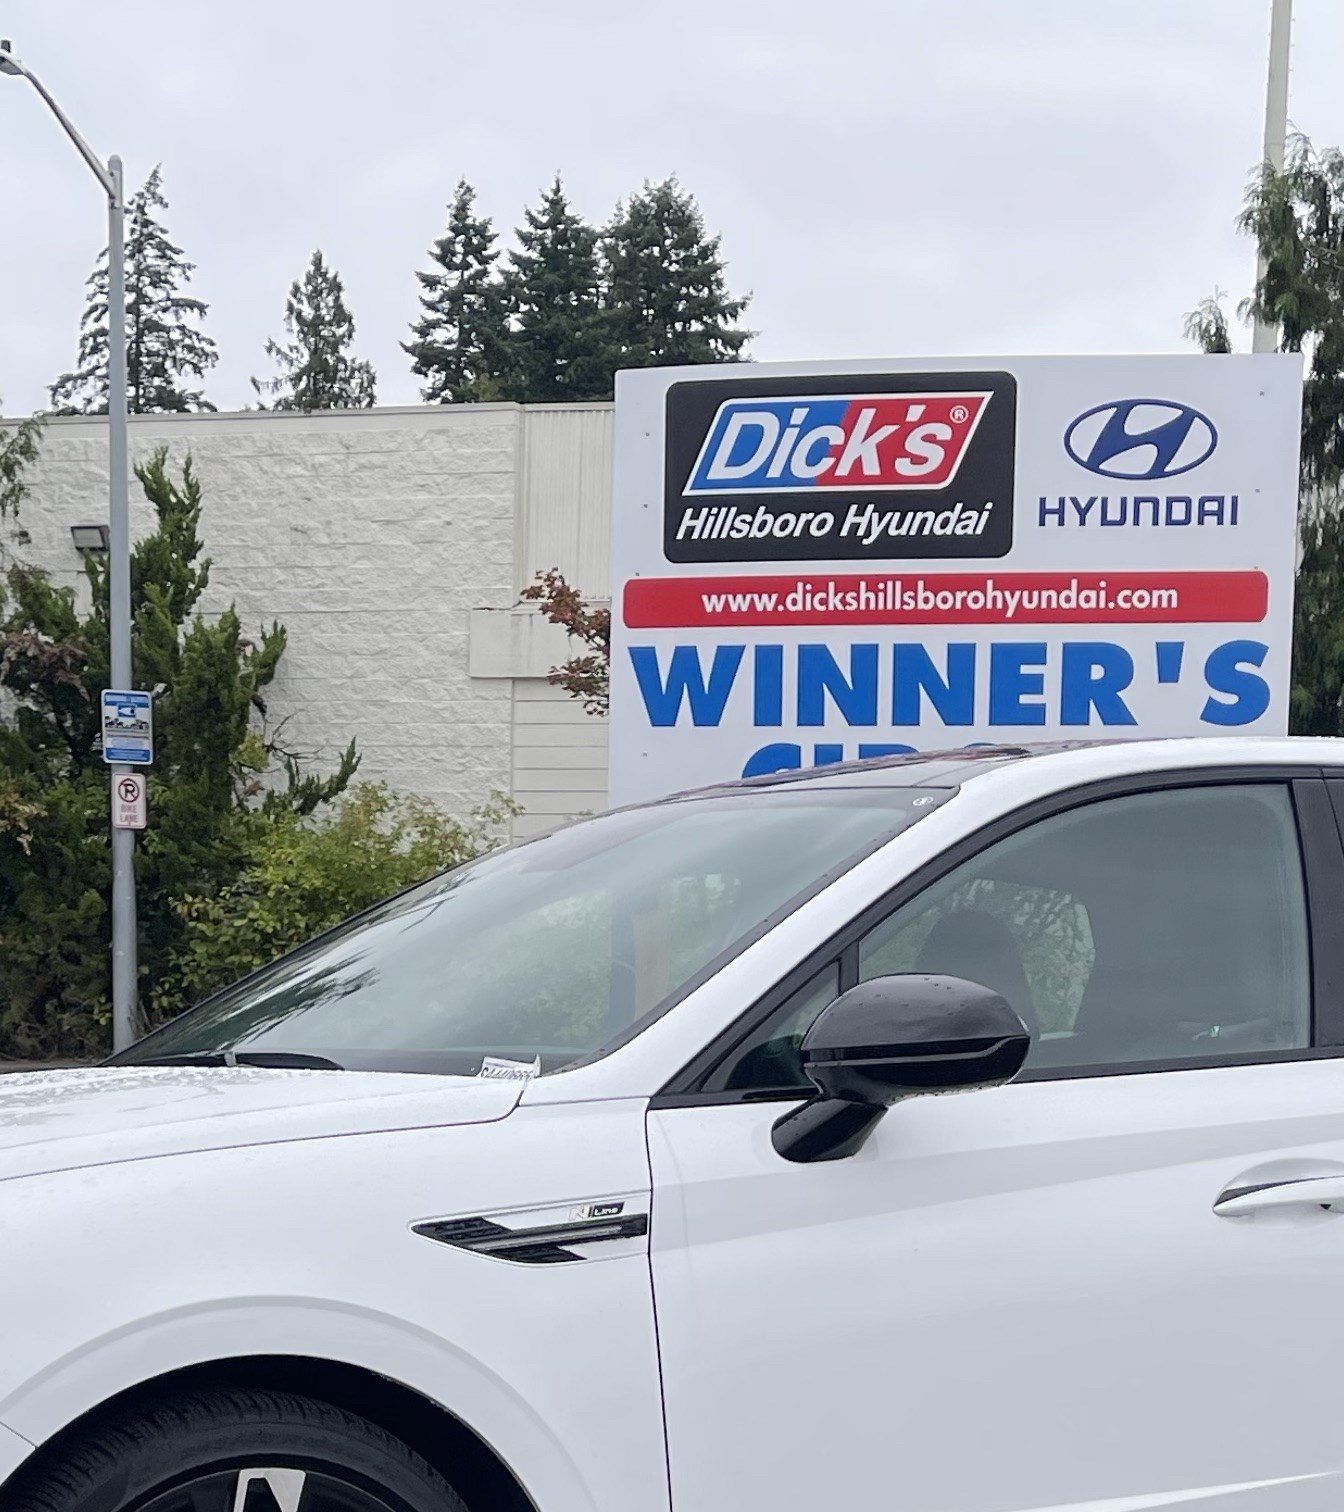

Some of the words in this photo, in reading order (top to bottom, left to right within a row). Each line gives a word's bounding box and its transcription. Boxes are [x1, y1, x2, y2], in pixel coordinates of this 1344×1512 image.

[676, 505, 834, 541] Hillsboro
[840, 502, 992, 545] Hyundai
[1038, 495, 1239, 528] HYUNDAI
[701, 578, 1178, 618] www.dickshillsborohyundai.com
[627, 639, 1270, 728] WINNER'S
